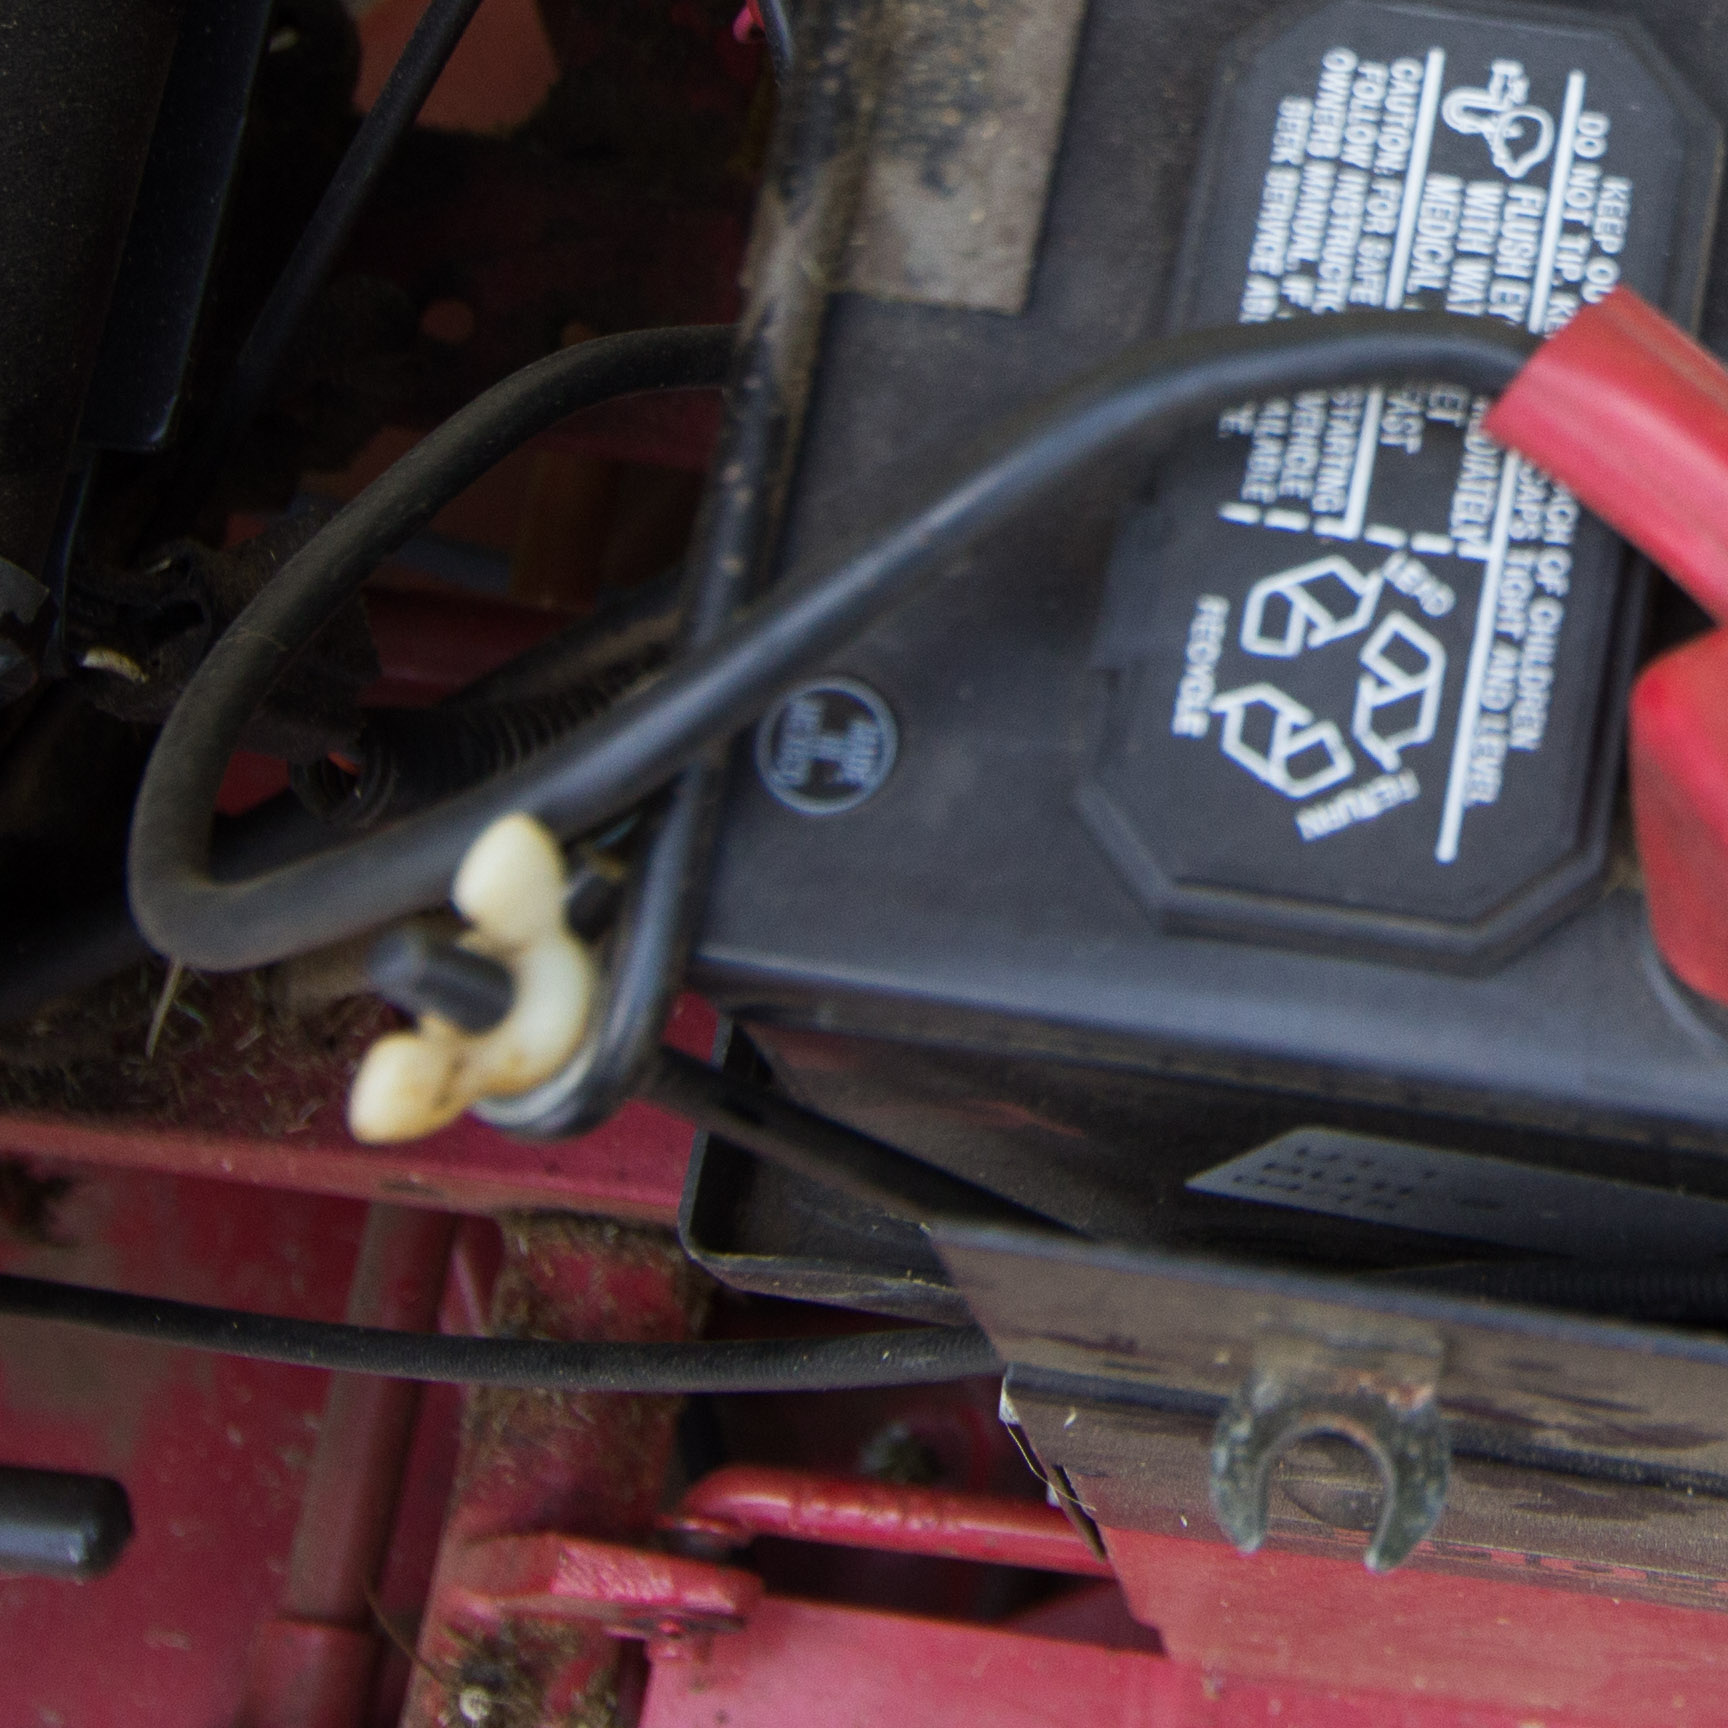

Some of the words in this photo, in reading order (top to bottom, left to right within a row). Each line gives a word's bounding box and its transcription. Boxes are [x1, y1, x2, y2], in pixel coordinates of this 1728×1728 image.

[1271, 98, 1317, 165] SEEK
[1300, 50, 1357, 158] OWNERS
[1337, 62, 1390, 168] FOLLOW
[1569, 111, 1608, 158] DO
[1249, 167, 1306, 275] SERVICE
[1359, 178, 1403, 234] FOR
[1405, 174, 1462, 291] MEDICAL
[1457, 182, 1502, 254] WITH
[1495, 185, 1546, 277] FLUSH
[1559, 163, 1599, 225] NOT
[1591, 176, 1629, 253] KEEP
[1280, 273, 1316, 307] IF
[1347, 236, 1391, 305] SAFE
[1272, 394, 1325, 497] VEHICLE
[1310, 393, 1370, 512] STARTING
[1488, 549, 1543, 638] TIGHT
[1531, 547, 1571, 595] OF
[1172, 596, 1228, 736] RECYCLE
[1479, 644, 1527, 711] AND
[1502, 597, 1562, 749] CHILDREN
[1462, 714, 1516, 805] LEVEL
